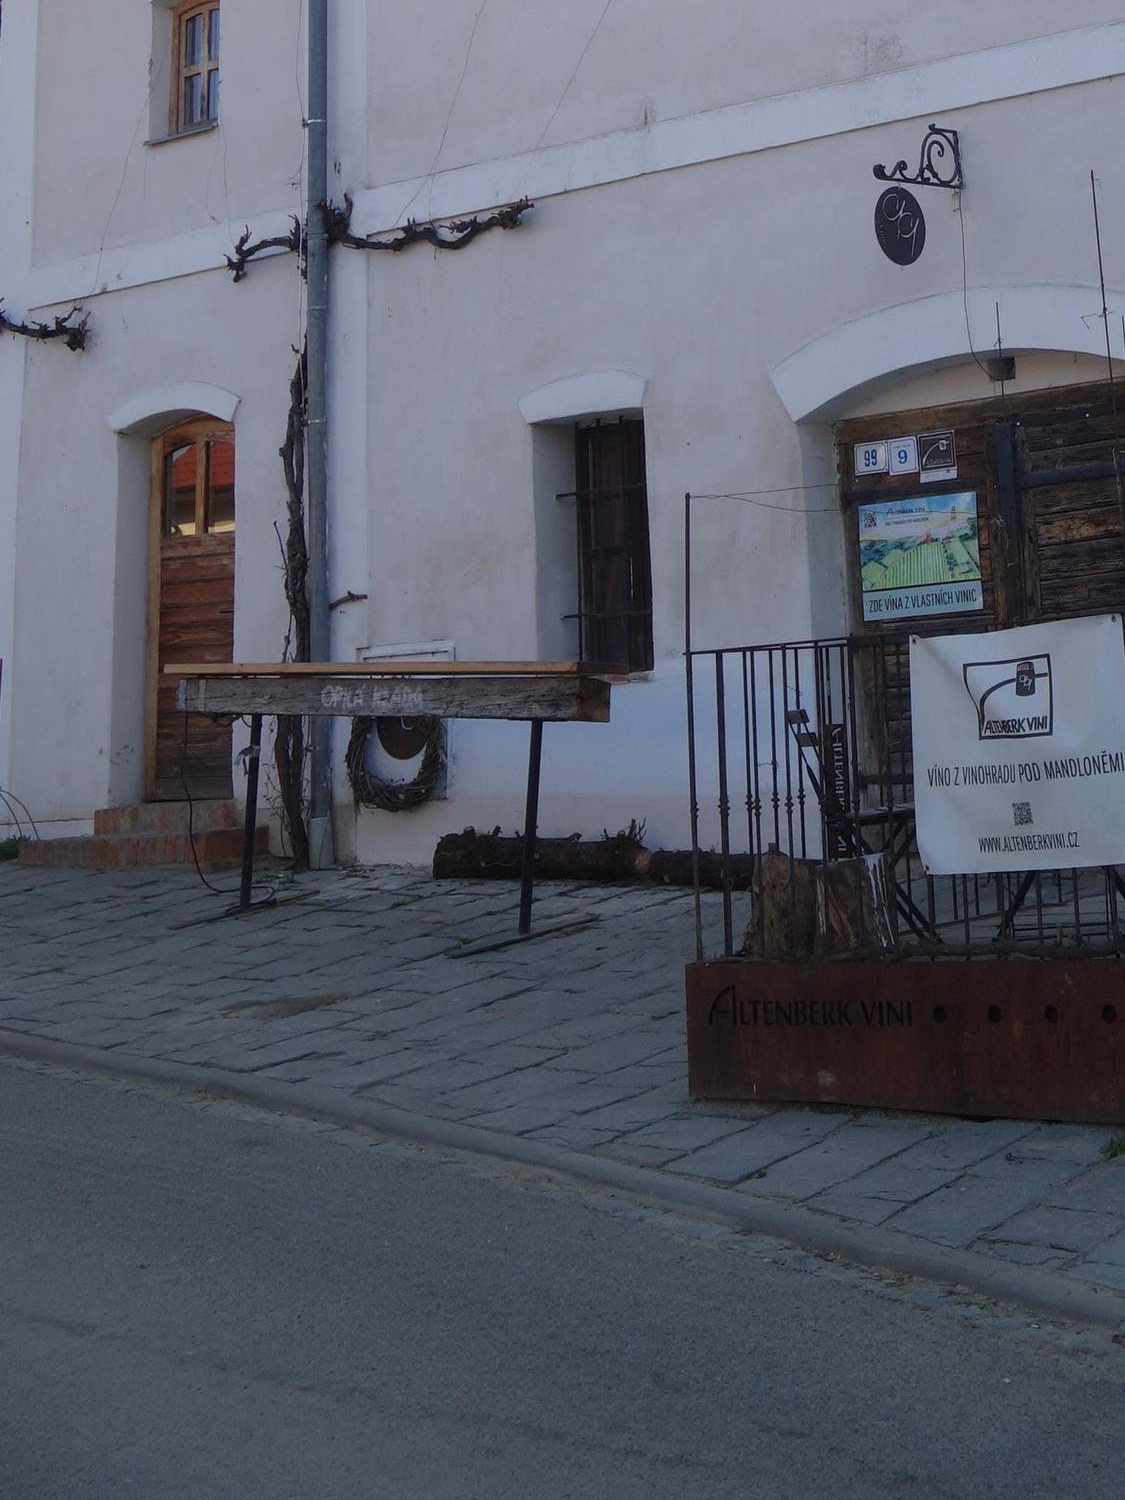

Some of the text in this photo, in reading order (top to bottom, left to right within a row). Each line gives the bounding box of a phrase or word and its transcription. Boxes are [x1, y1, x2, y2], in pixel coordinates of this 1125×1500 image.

[864, 449, 878, 467] 99
[897, 449, 908, 465] 9
[869, 588, 977, 613] ZDE VÍNA Z VLASTNÍCH VINIC
[984, 716, 1048, 735] ALTENBERK VINI
[927, 750, 1125, 787] VÍNO Z VINOHRADU POD MANDLONĚMI
[978, 831, 1080, 853] WWW.ALTENBERKVINI.CZ
[708, 984, 913, 1026] ALTENBERK VINI
